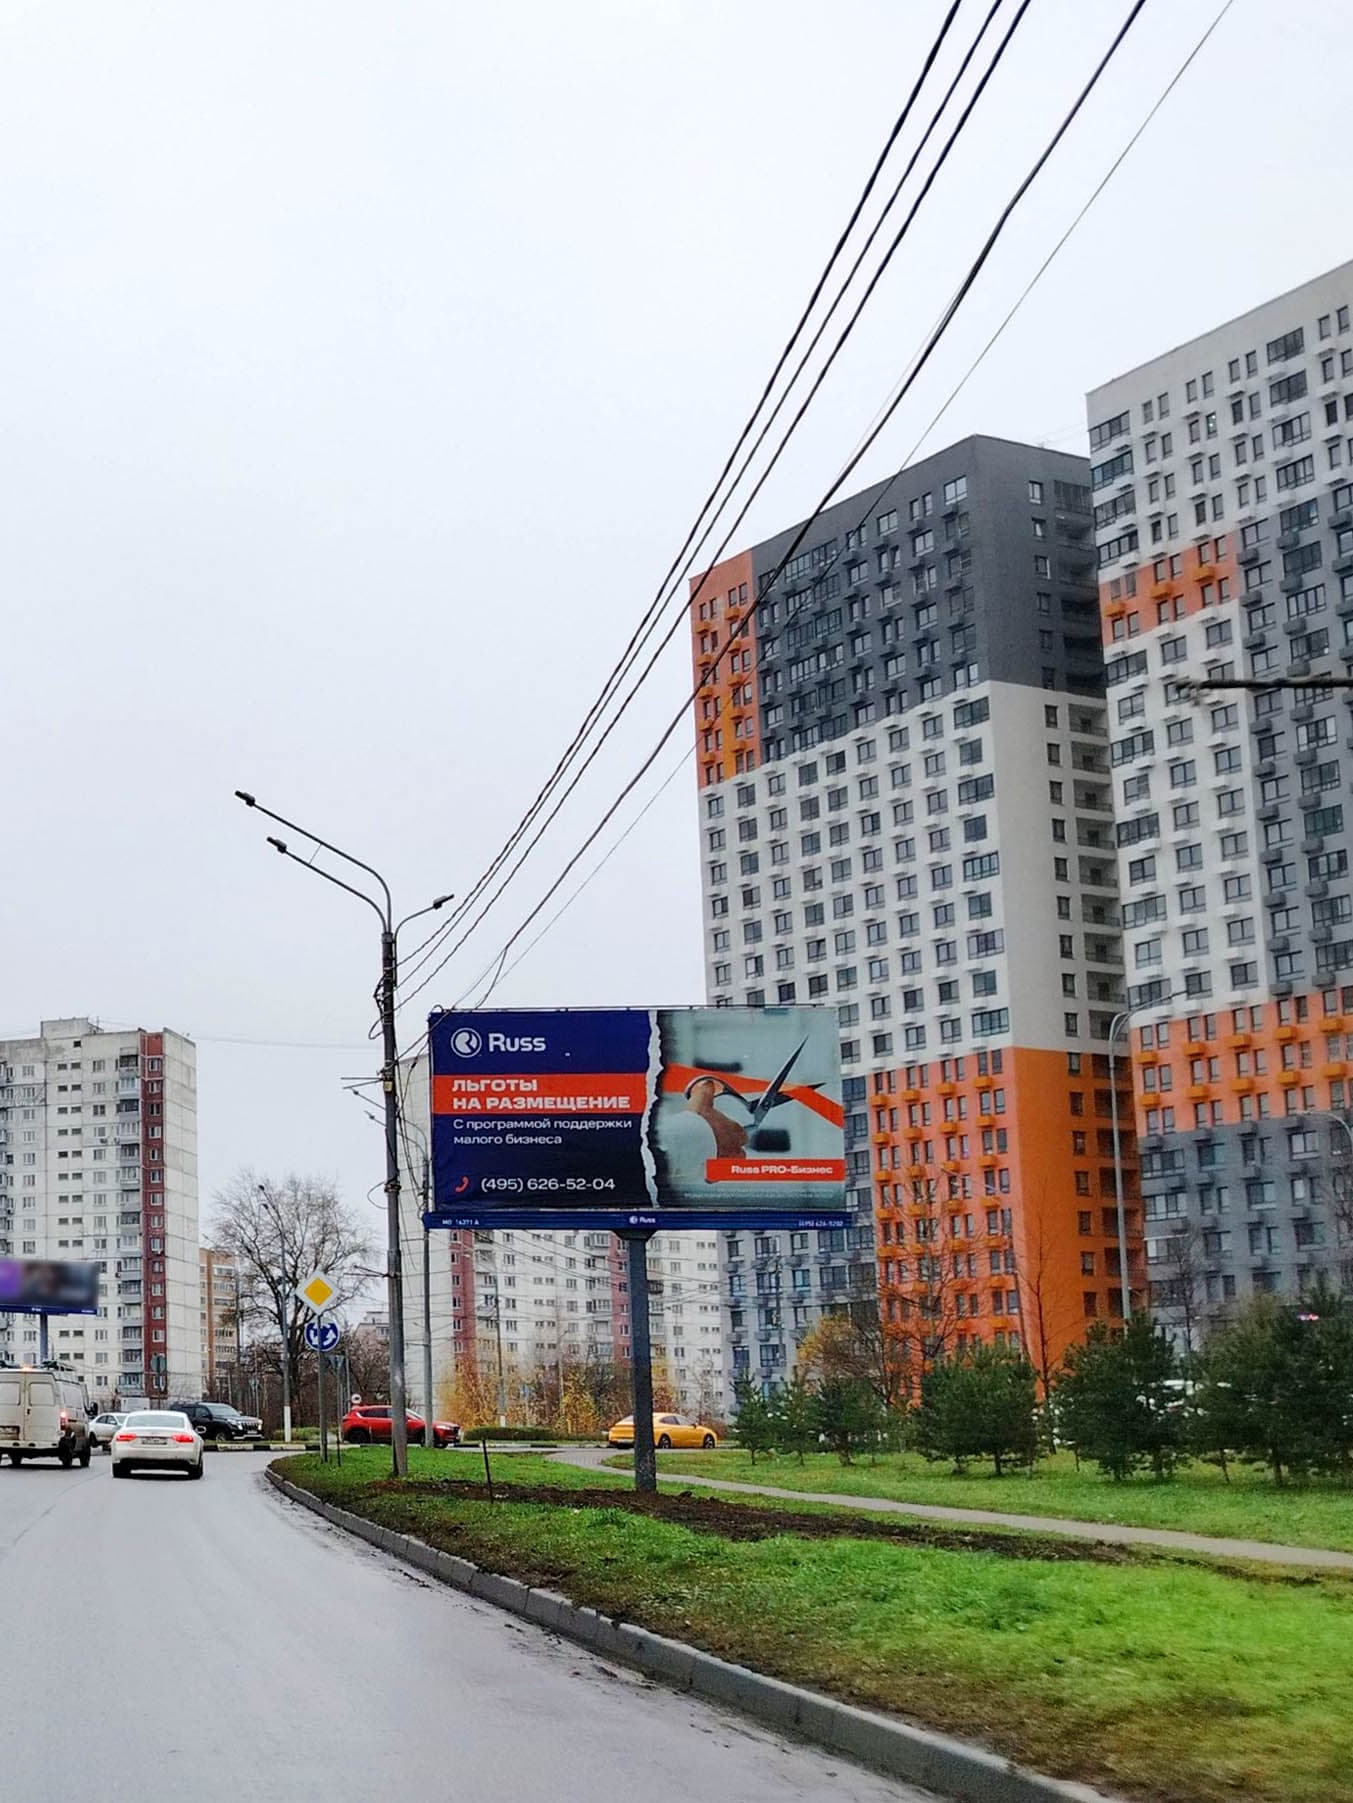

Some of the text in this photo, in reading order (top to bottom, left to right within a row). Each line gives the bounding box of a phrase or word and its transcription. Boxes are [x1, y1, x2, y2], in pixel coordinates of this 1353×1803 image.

[488, 1033, 546, 1052] Russ
[452, 1079, 538, 1092] ЛЬГОТЫ
[453, 1096, 631, 1111] НА РАЗМЕЩЕНИЕ
[453, 1118, 633, 1131] С программой поддержки
[453, 1134, 562, 1145] малого бизнеса
[731, 1165, 759, 1174] Russ
[481, 1178, 616, 1193] (495) 626-52-04
